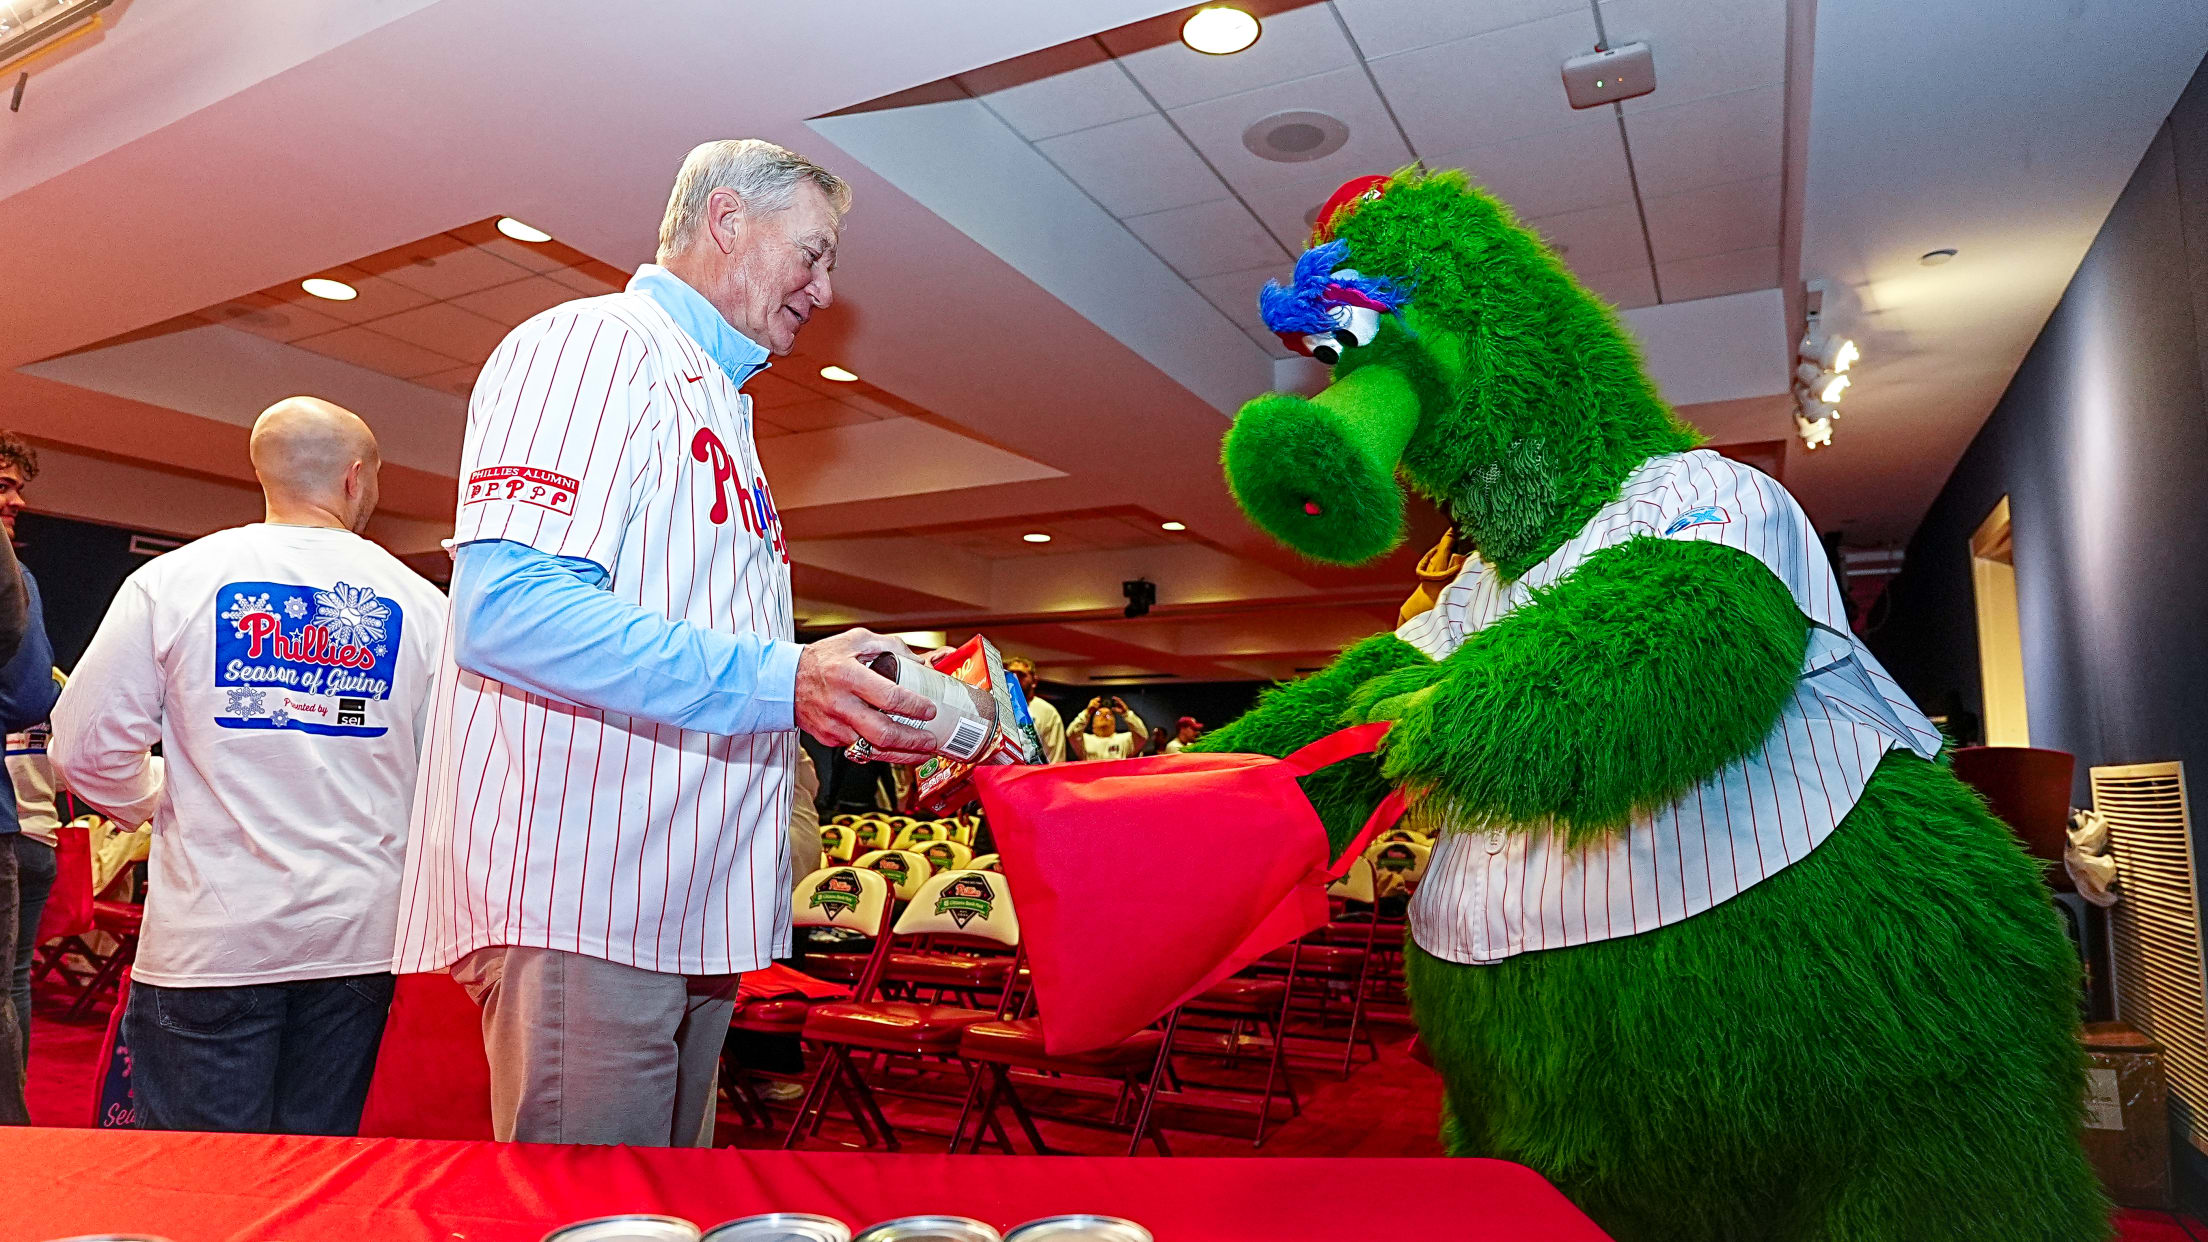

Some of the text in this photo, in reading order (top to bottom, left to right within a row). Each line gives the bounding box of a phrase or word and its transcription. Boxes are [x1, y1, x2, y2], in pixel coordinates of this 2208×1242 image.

[472, 468, 577, 489] PHILLIES ALUMNI
[485, 483, 499, 496] P
[506, 480, 525, 499] P
[530, 486, 546, 500] P
[551, 492, 567, 505] P
[238, 612, 376, 670] Phillies
[224, 659, 388, 700] Season of Giving
[284, 698, 329, 717] Pnted by
